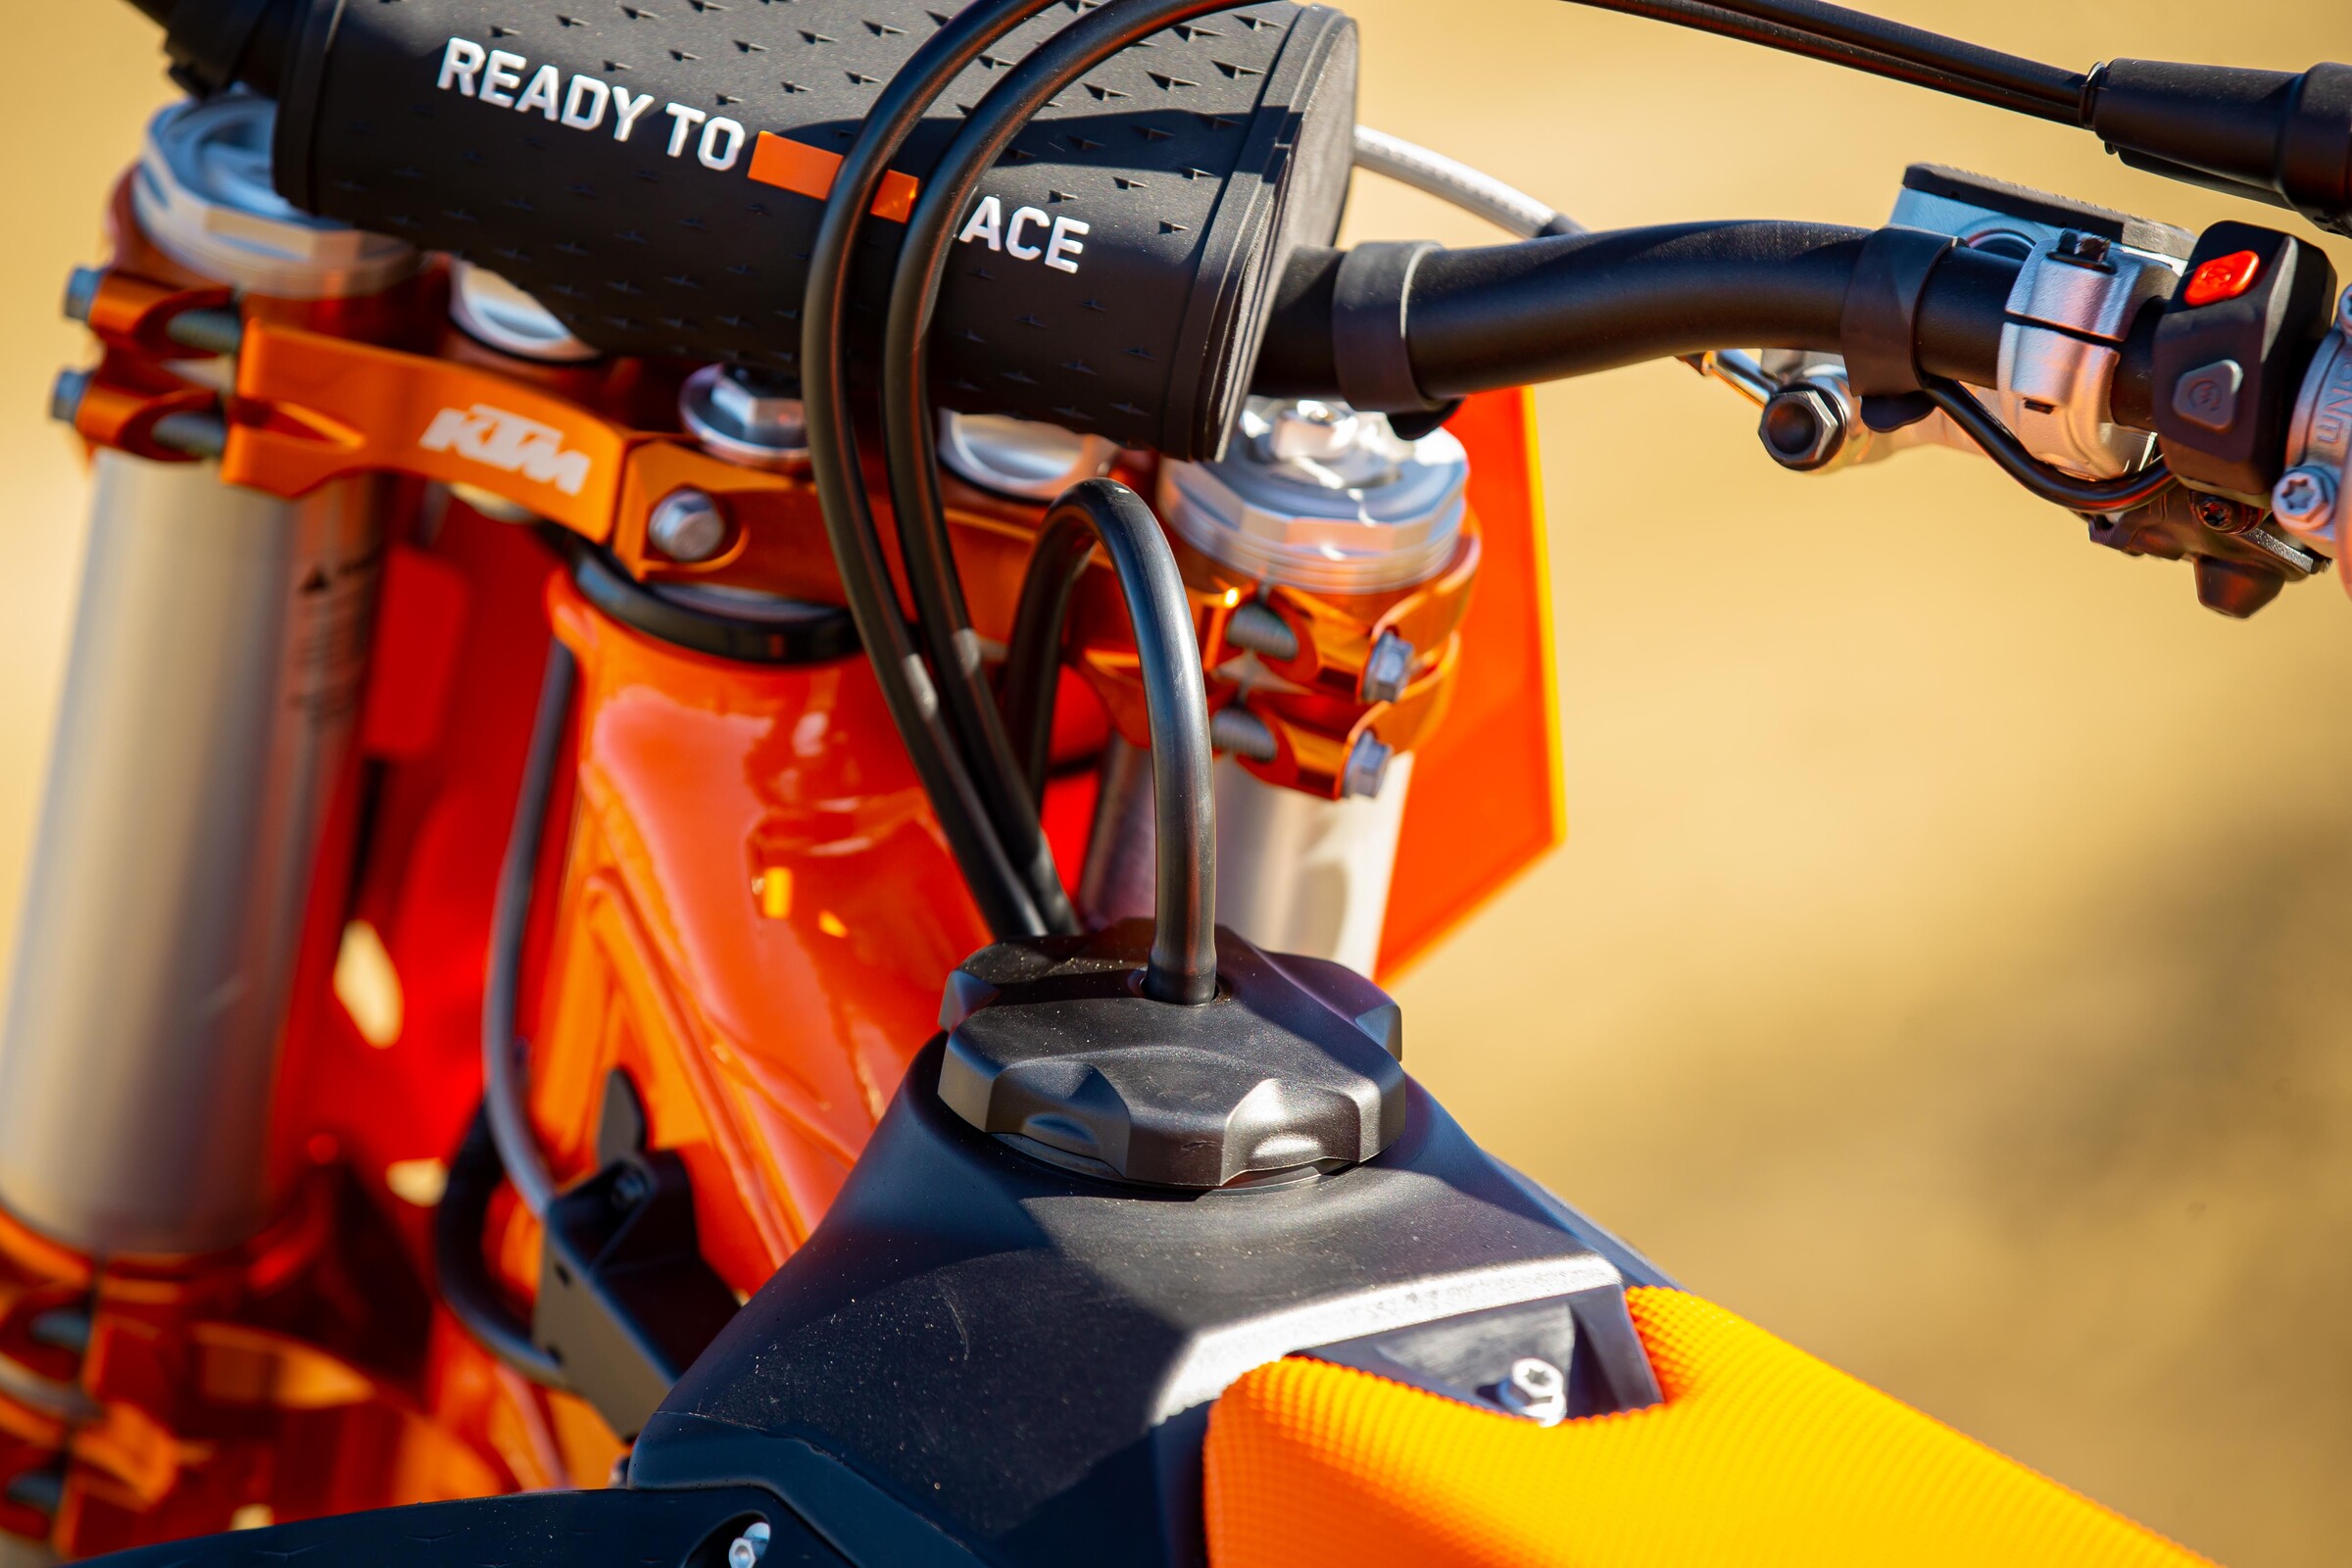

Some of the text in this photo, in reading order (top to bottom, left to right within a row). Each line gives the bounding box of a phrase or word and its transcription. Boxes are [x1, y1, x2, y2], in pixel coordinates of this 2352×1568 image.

[437, 36, 1091, 274] READY TO ACE
[418, 403, 591, 497] KTM
